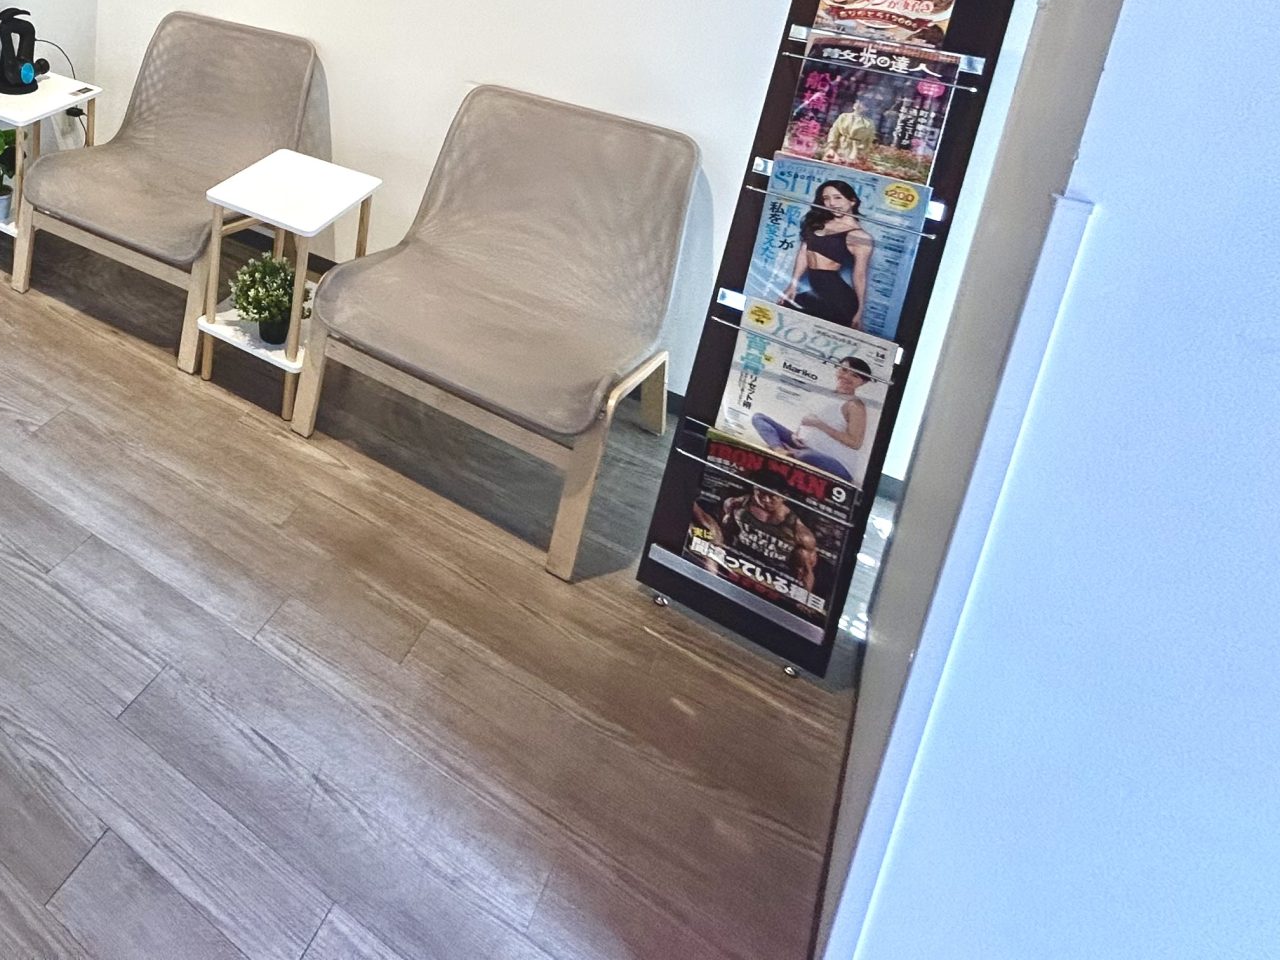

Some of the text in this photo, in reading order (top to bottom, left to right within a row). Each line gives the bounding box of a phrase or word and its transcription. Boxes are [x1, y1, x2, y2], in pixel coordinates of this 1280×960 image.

[822, 43, 942, 78] 散歩の達人
[782, 361, 819, 381] Mariko
[831, 486, 846, 503] 9
